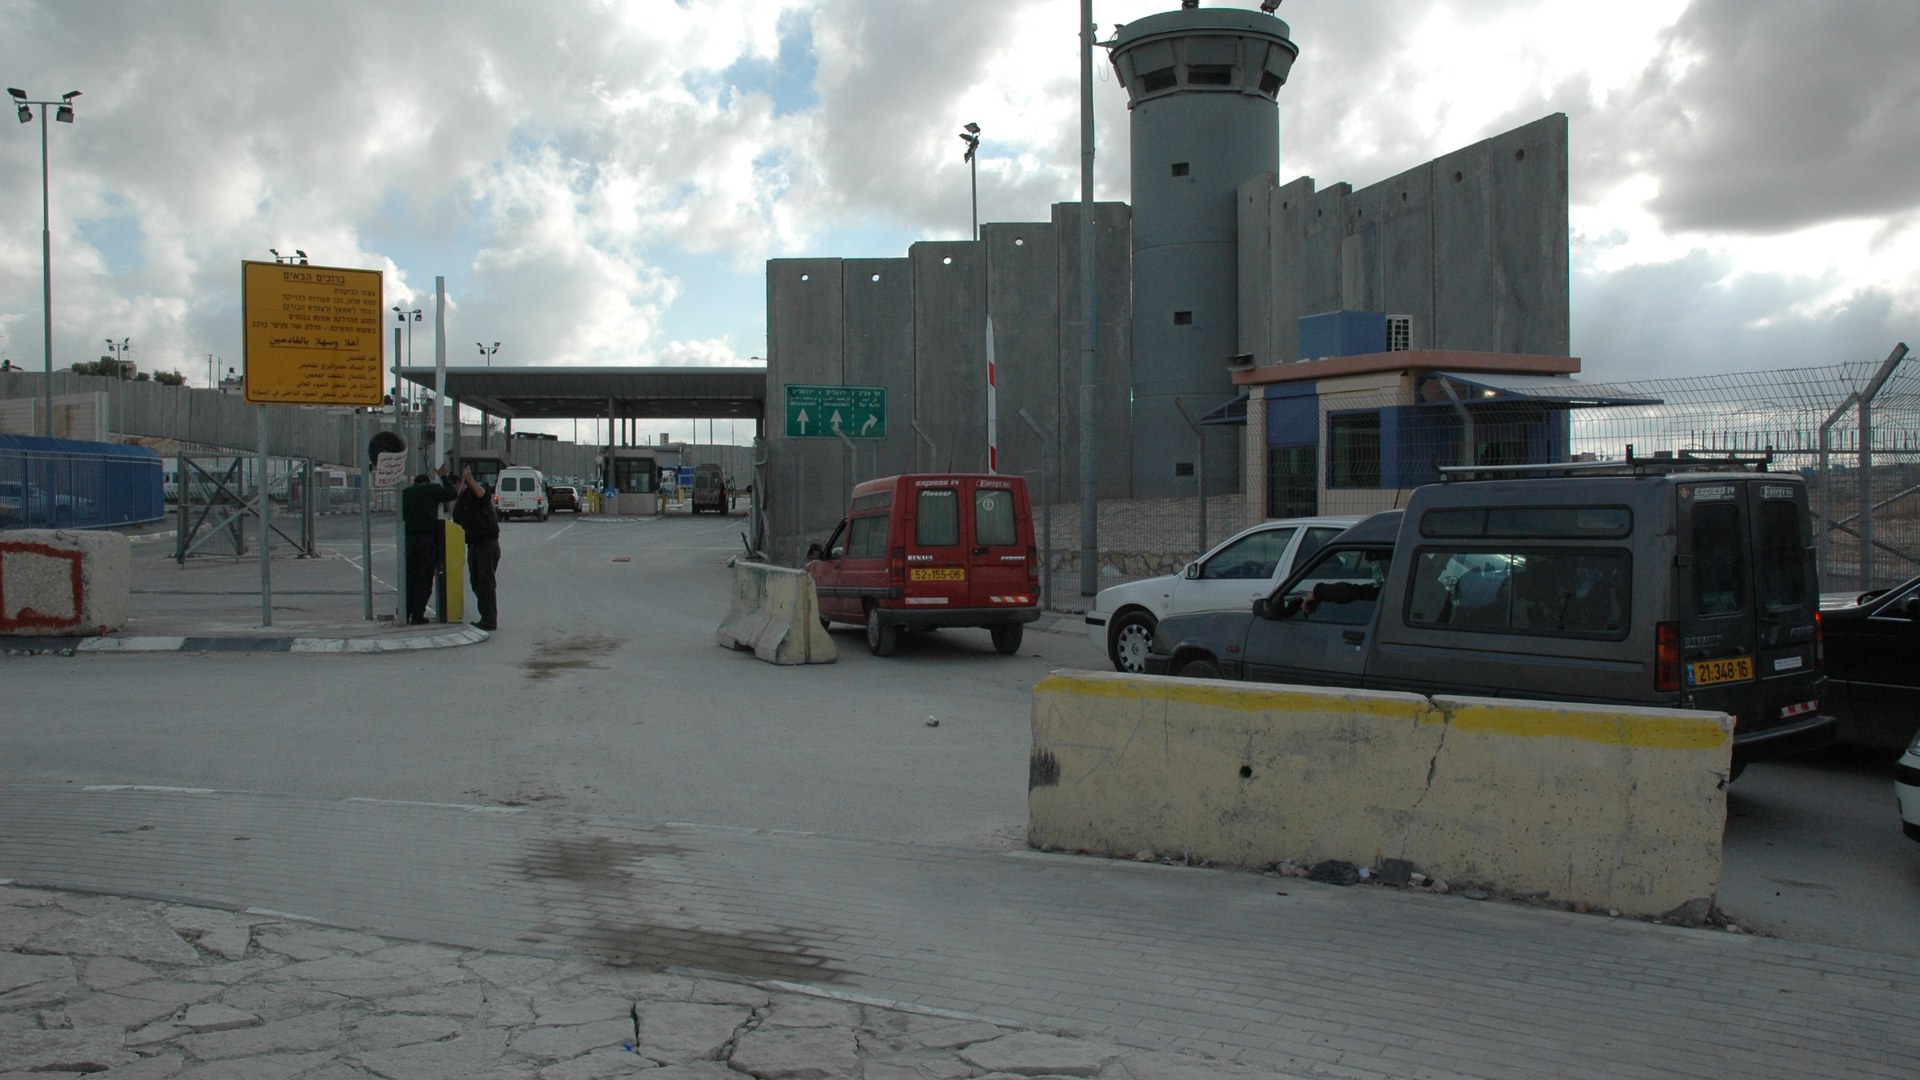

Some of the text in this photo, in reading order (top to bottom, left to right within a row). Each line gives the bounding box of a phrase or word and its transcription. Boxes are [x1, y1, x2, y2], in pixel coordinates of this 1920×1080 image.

[283, 272, 345, 284] ברוכים הבאים
[269, 336, 359, 349] أهلا وسهلا بالقادمين
[1695, 487, 1726, 496] express
[915, 570, 961, 579] 52-155-06
